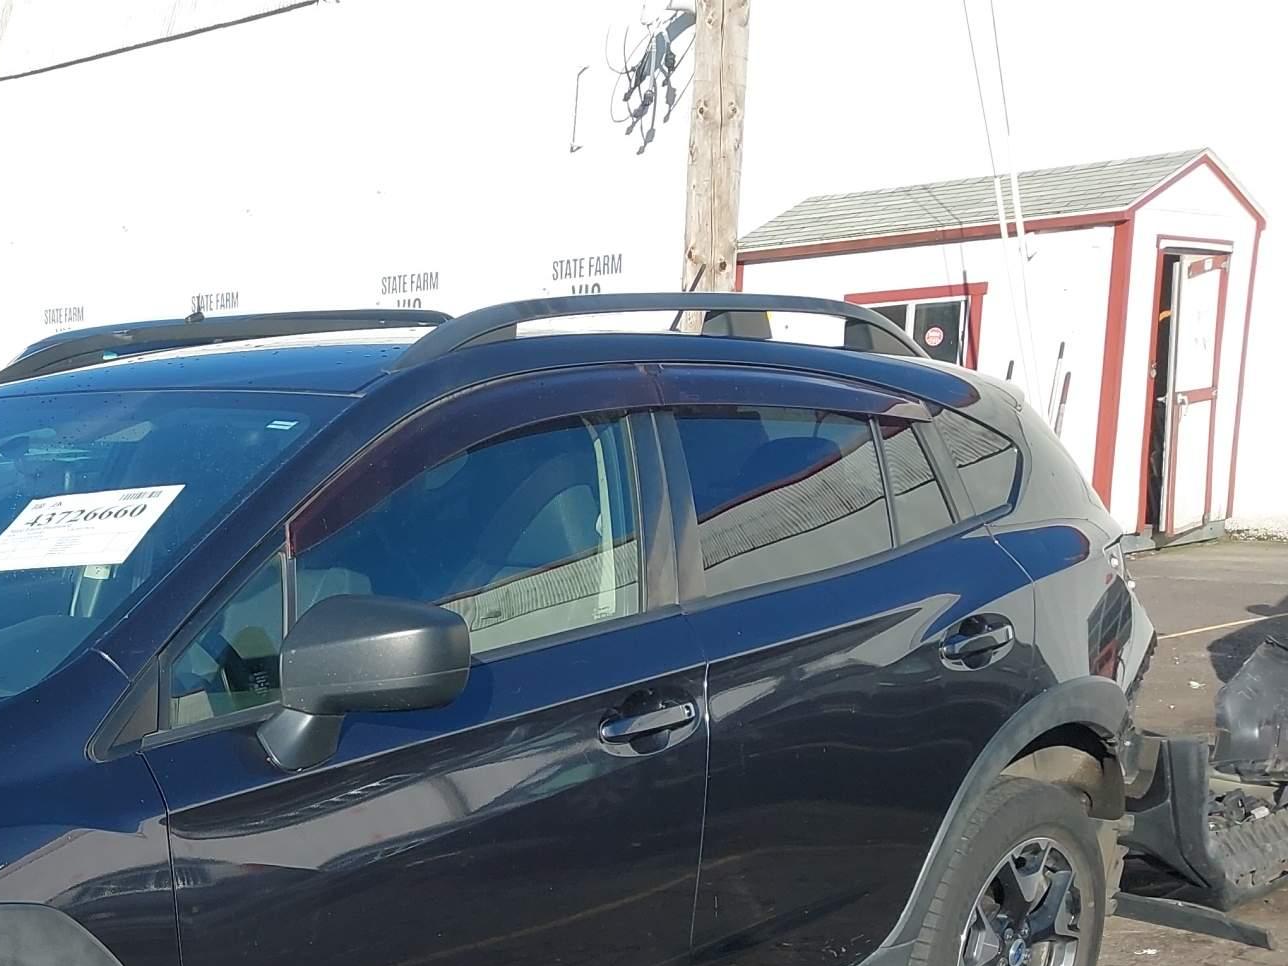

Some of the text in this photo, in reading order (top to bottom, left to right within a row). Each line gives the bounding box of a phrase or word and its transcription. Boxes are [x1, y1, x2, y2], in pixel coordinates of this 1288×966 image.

[552, 253, 623, 280] STATE FARM
[381, 271, 439, 296] STATE FARM
[191, 291, 239, 313] STATE FARM
[44, 306, 84, 325] STATE FARM
[26, 503, 148, 528] 43726660
